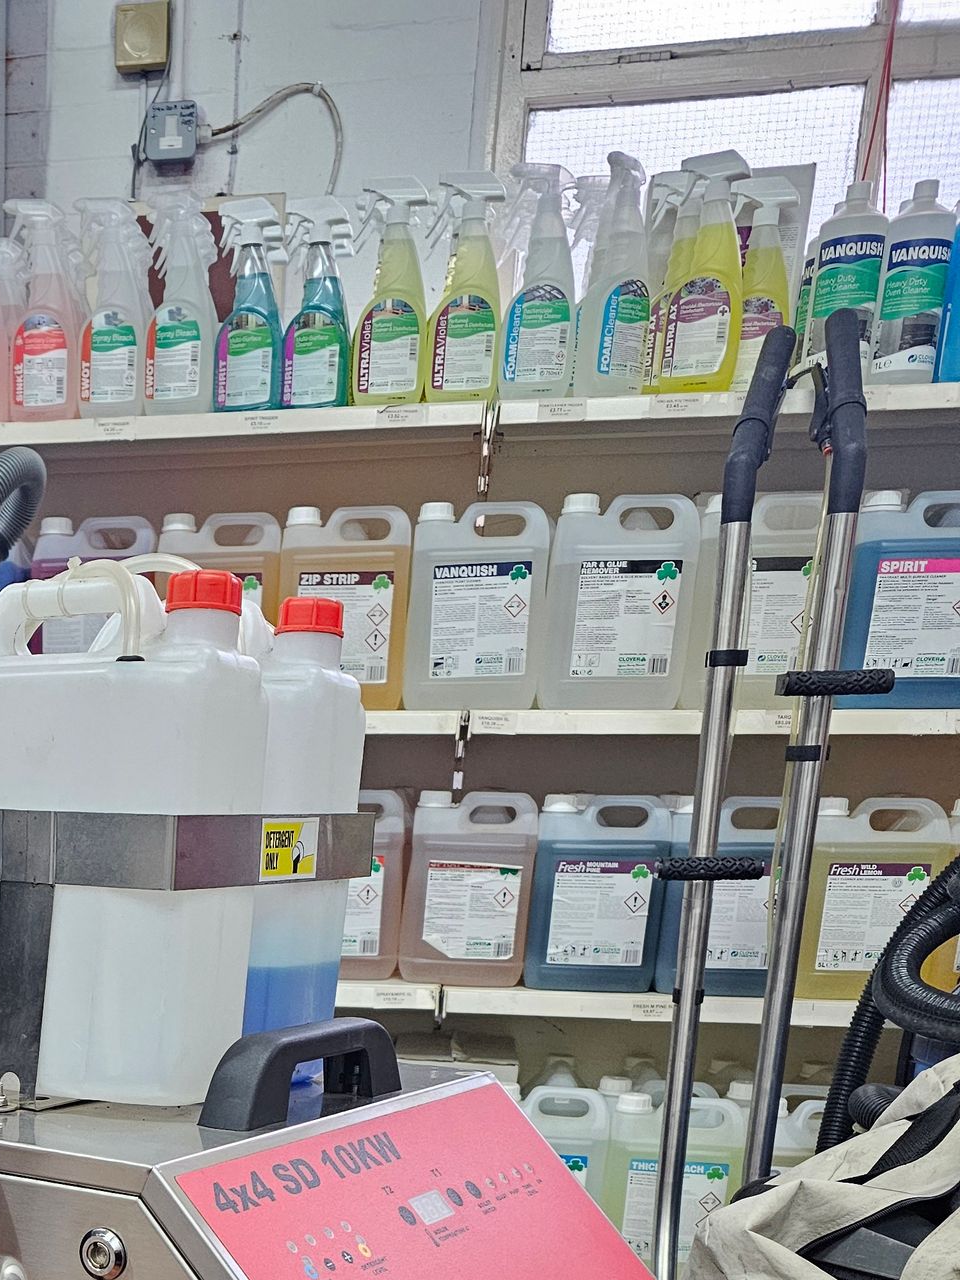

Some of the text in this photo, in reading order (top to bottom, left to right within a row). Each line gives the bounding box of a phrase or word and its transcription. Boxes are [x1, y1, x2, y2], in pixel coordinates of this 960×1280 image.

[822, 241, 884, 262] VANQUISH
[837, 274, 856, 284] Duty
[601, 294, 618, 371] FOAMCleaner
[360, 319, 372, 389] ULTRAViolet
[434, 315, 447, 386] ULTRAViolet
[81, 362, 90, 398] SWOT
[145, 358, 154, 396] SWOT
[218, 359, 228, 403] SPIRIT
[283, 358, 293, 401] SPIRIT
[435, 564, 498, 579] VANQUISH
[881, 560, 928, 573] SPIRIT
[300, 573, 360, 585] ZIP STRIP
[265, 830, 295, 849] DETERGENT
[265, 852, 279, 870] ONLY
[558, 861, 585, 873] Fresh
[830, 864, 859, 875] Fresh
[213, 1131, 402, 1214] 4x4 SD 10KW
[430, 1168, 442, 1178] T1
[632, 1161, 657, 1171] THIC
[381, 1185, 394, 1196] T2
[372, 1267, 389, 1276] LEVEL
